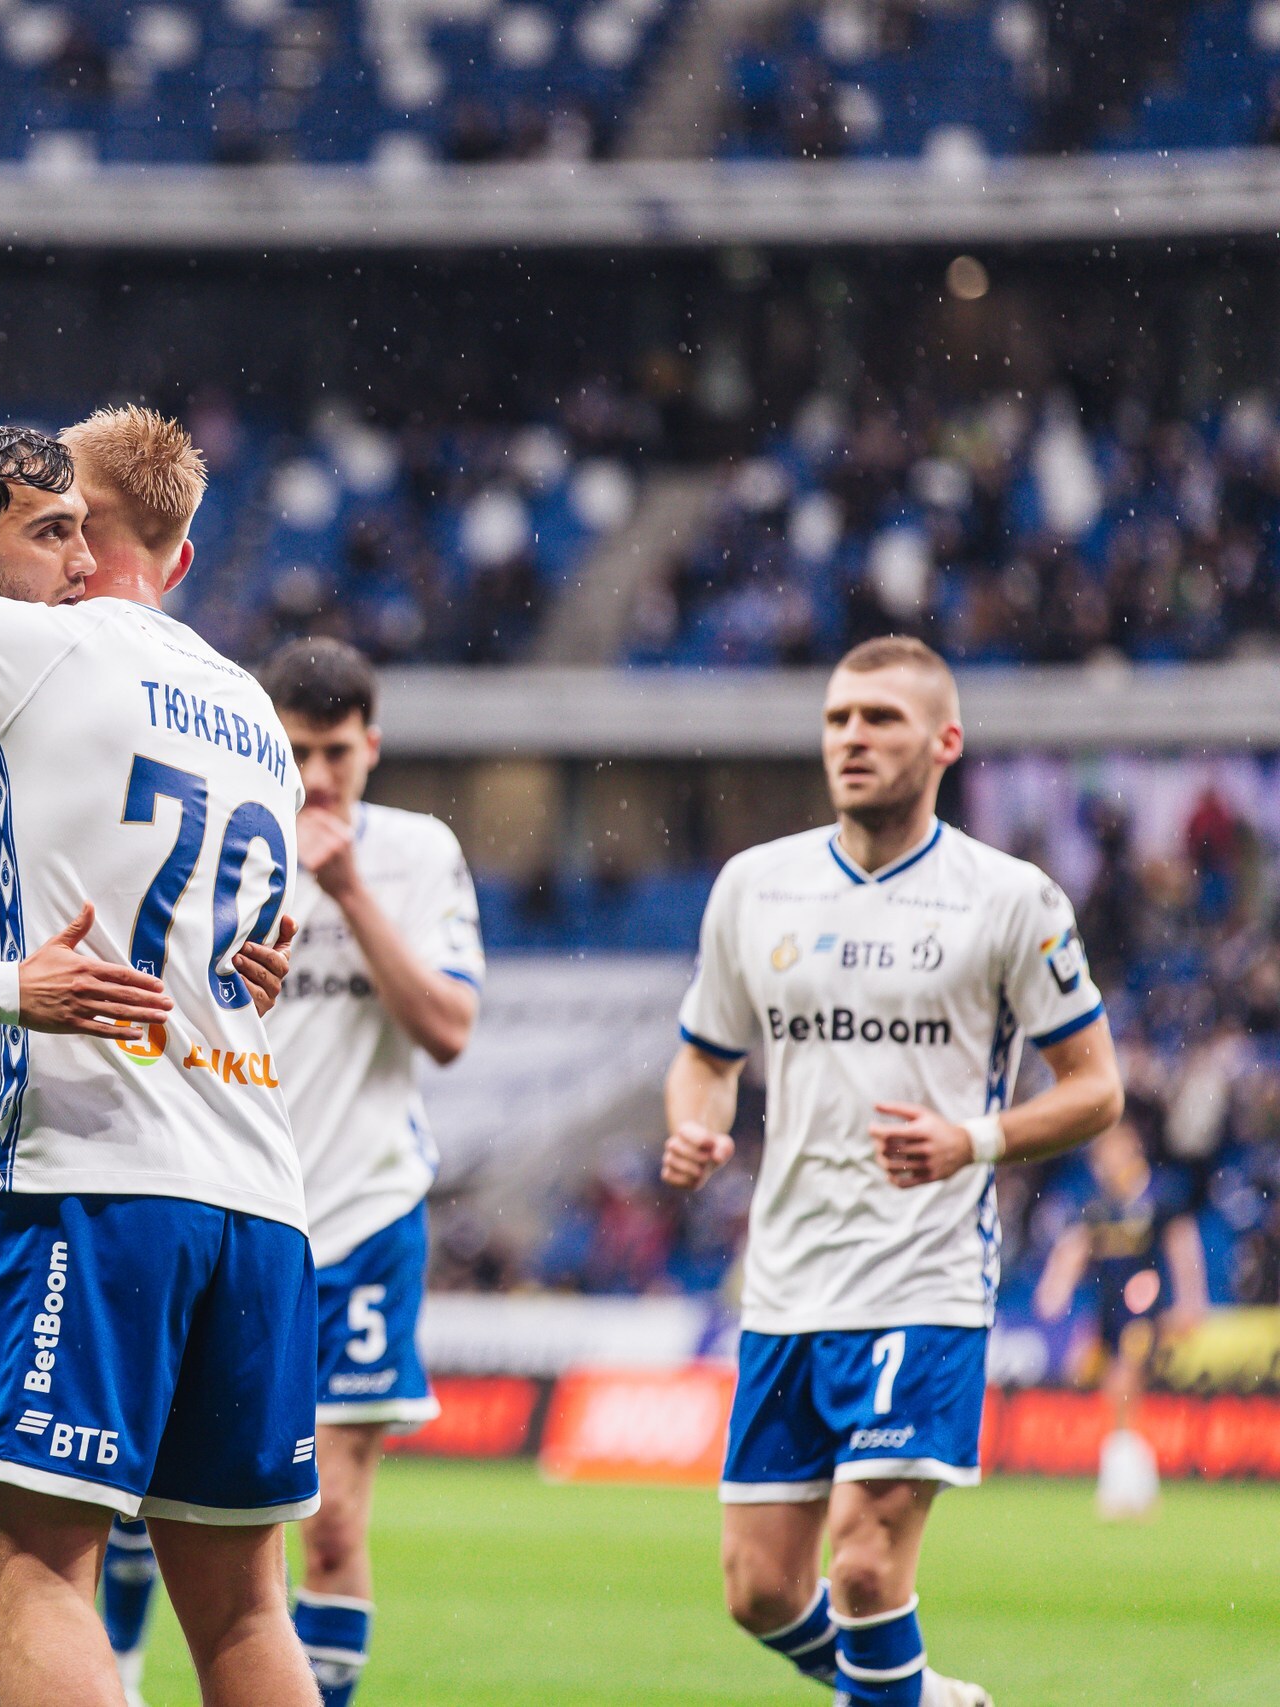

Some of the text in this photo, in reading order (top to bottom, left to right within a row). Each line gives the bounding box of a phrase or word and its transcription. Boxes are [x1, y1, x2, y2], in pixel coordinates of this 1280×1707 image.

[141, 680, 286, 787] ТЮКАВИН
[120, 752, 287, 1012] 70
[841, 941, 894, 969] ВТБ
[768, 1007, 951, 1045] BetBoom
[24, 1241, 68, 1394] BetBoom
[345, 1283, 388, 1364] 5
[871, 1330, 906, 1415] 7
[49, 1422, 120, 1466] ВТБ
